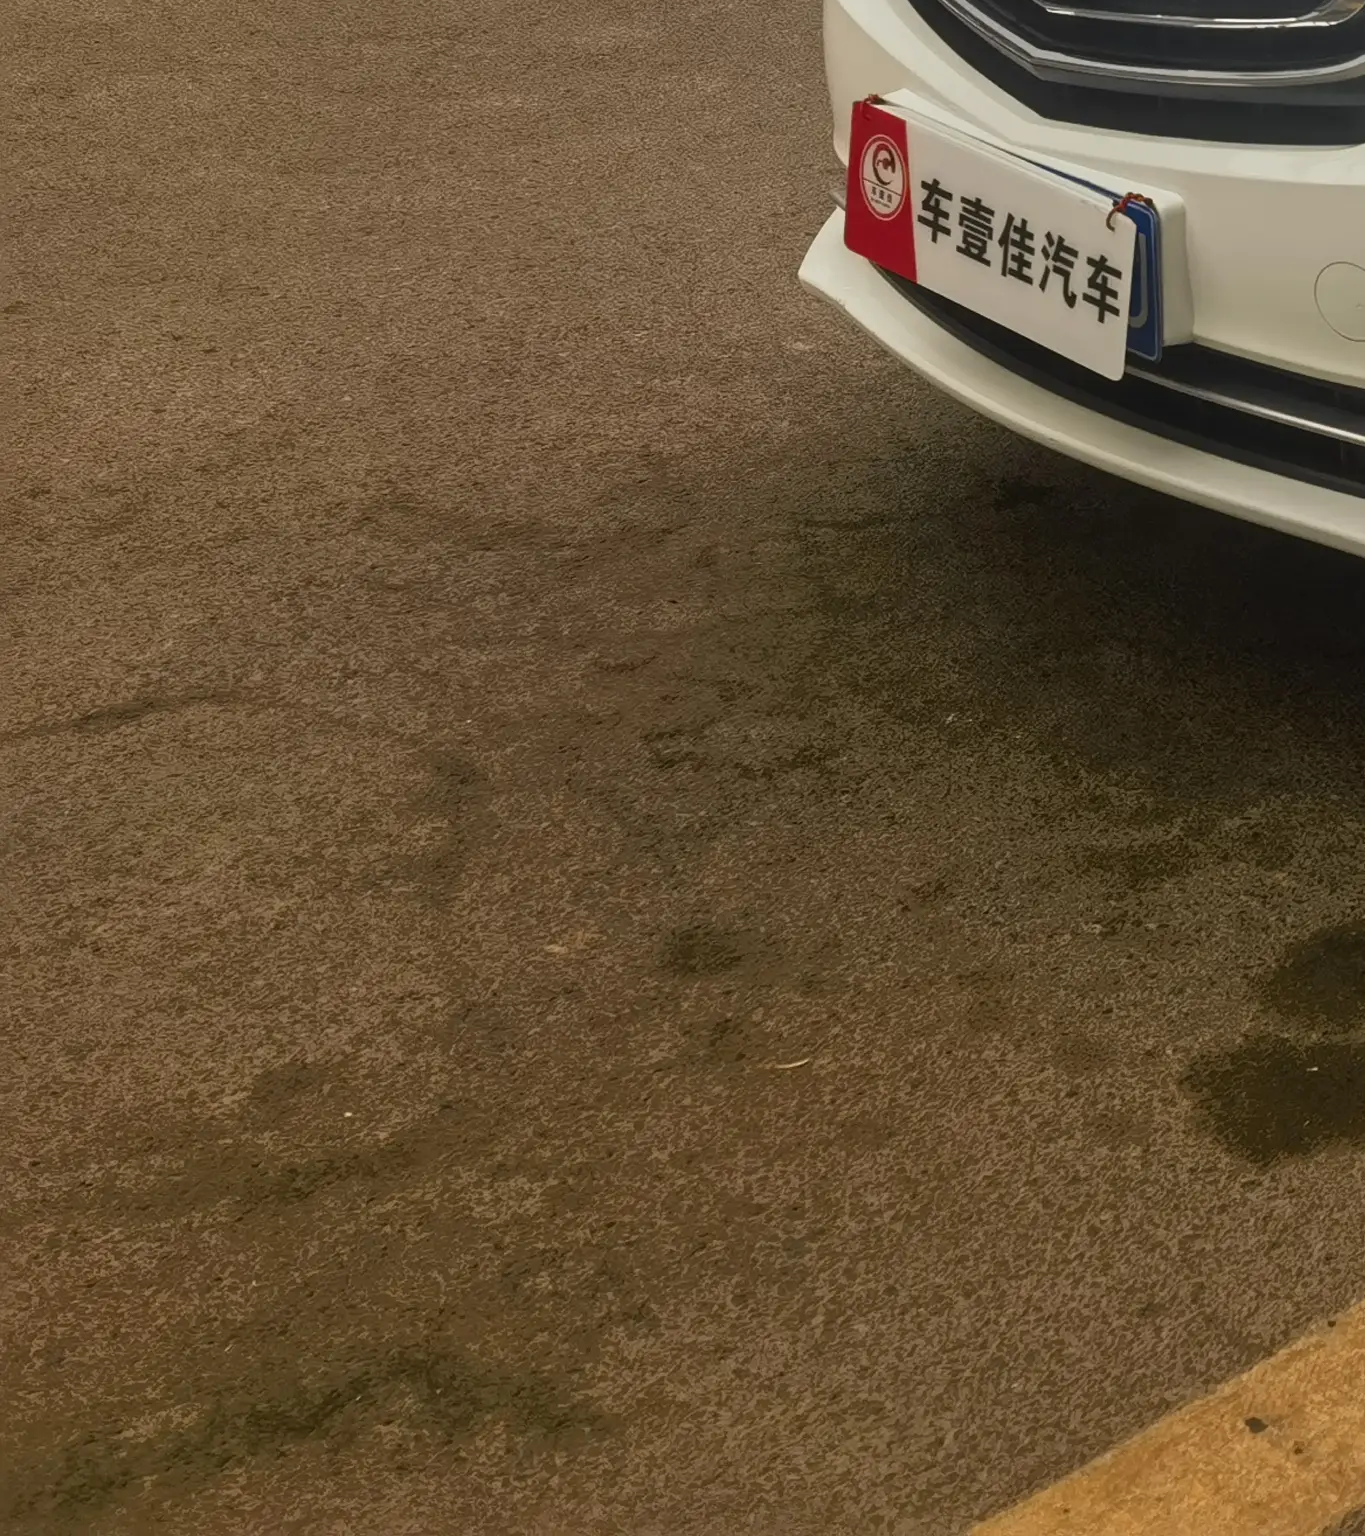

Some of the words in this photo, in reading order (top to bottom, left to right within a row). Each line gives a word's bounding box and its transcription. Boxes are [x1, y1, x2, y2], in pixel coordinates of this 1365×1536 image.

[917, 178, 1122, 324] 车壹佳汽车
